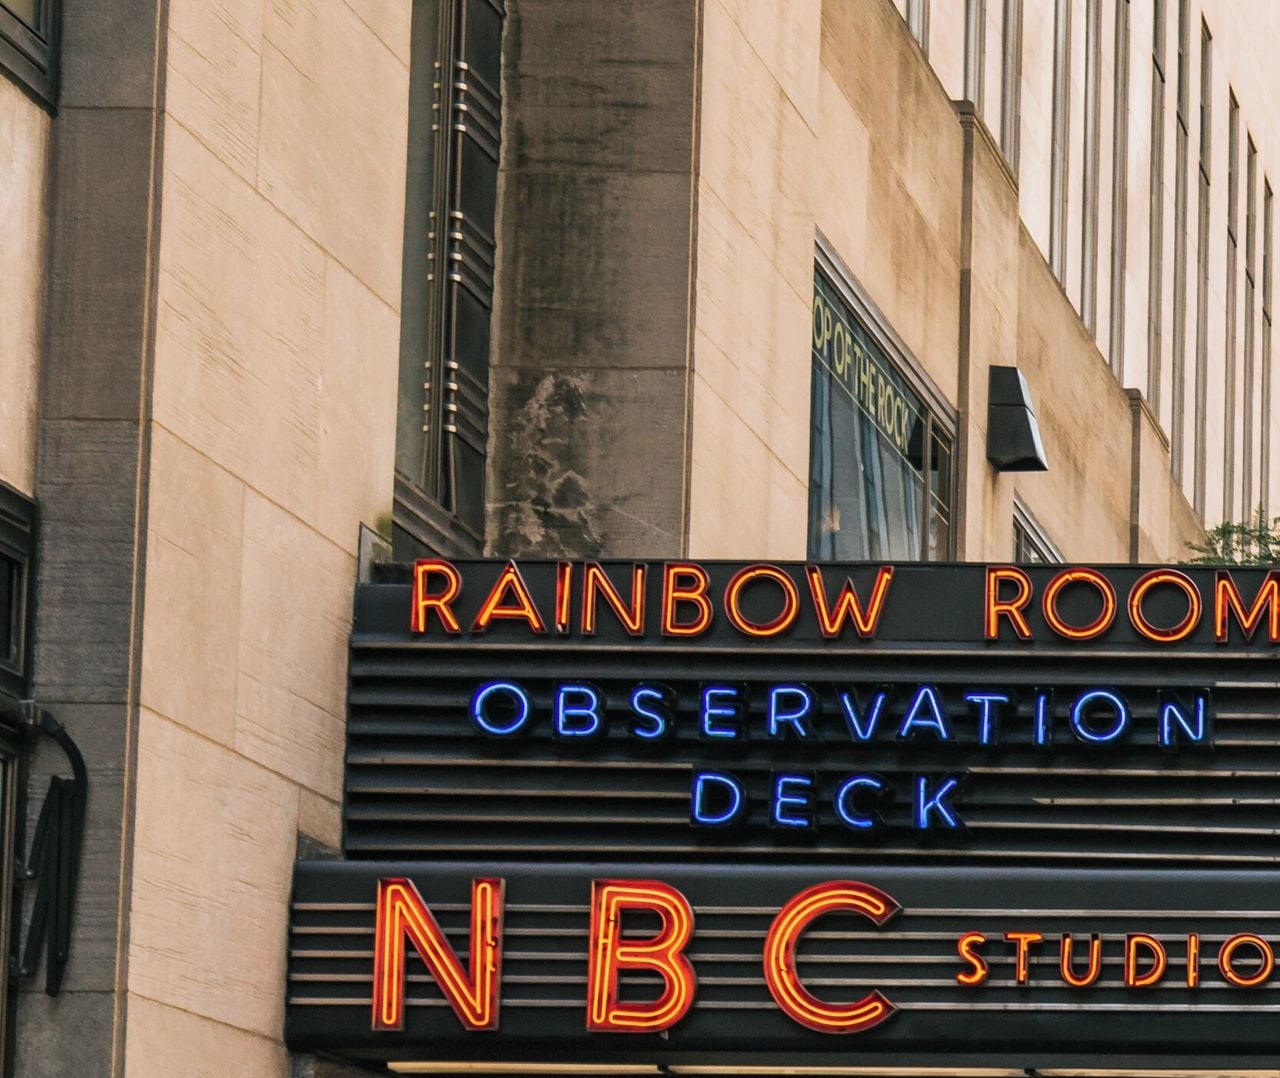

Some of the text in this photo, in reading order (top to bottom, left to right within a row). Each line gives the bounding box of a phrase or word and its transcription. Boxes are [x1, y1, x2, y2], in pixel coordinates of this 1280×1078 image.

[411, 559, 893, 638] RAINBOW
[470, 680, 1212, 748] OBSERVATION
[691, 771, 966, 832] DECK
[371, 877, 903, 1034] NBC
